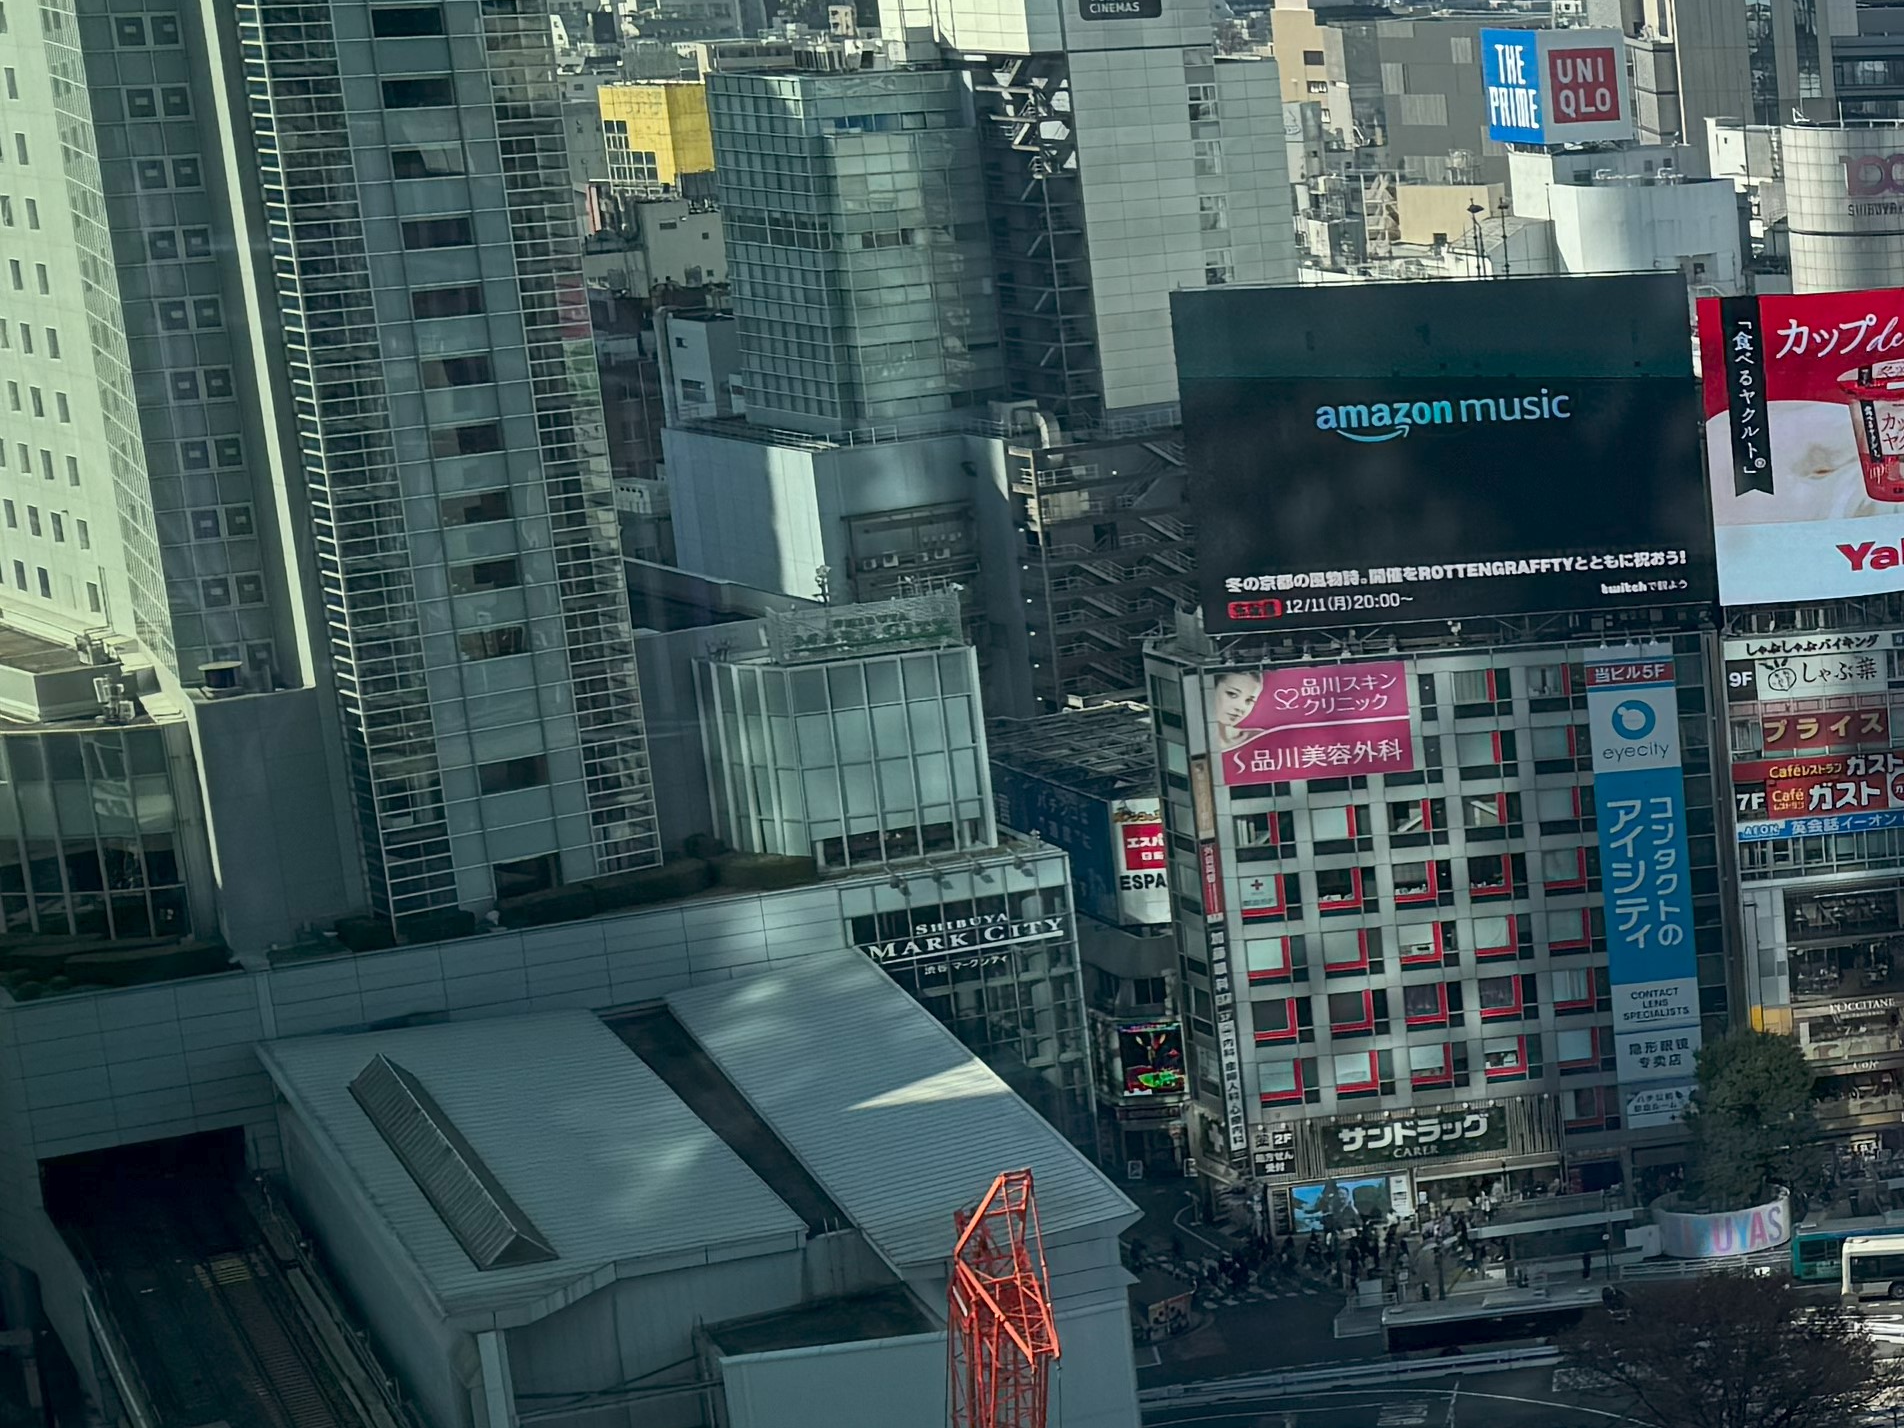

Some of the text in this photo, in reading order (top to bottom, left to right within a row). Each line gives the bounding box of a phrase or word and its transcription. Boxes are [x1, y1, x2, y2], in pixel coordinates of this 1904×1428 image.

[1089, 2, 1140, 13] CINEMAS
[1495, 44, 1525, 85] THE
[1556, 58, 1605, 84] UNI
[1489, 87, 1540, 129] PRIME
[1559, 88, 1611, 117] QLO
[1315, 388, 1571, 434] amazon music
[1300, 671, 1397, 698] 品川スキン
[1595, 664, 1665, 682] 当ビル5F
[1728, 672, 1753, 687] 9F
[1303, 692, 1389, 715] クリニック
[1763, 713, 1888, 743] プライス
[1251, 738, 1403, 772] 品川美容外科
[1603, 742, 1669, 759] eyecity
[1847, 752, 1904, 776] ガスト
[1736, 792, 1765, 811] 7F
[1808, 781, 1881, 811] ガスト
[1607, 800, 1651, 949] アイシティ
[1649, 797, 1684, 946] コンタクトの
[916, 912, 1008, 935] SHIBUYA
[869, 917, 1063, 960] MARK CITY
[1630, 986, 1679, 1001] CONTACT
[1653, 999, 1668, 1007] LENS
[1274, 1133, 1291, 1145] 2F
[1338, 1113, 1492, 1153] サンドラッグ
